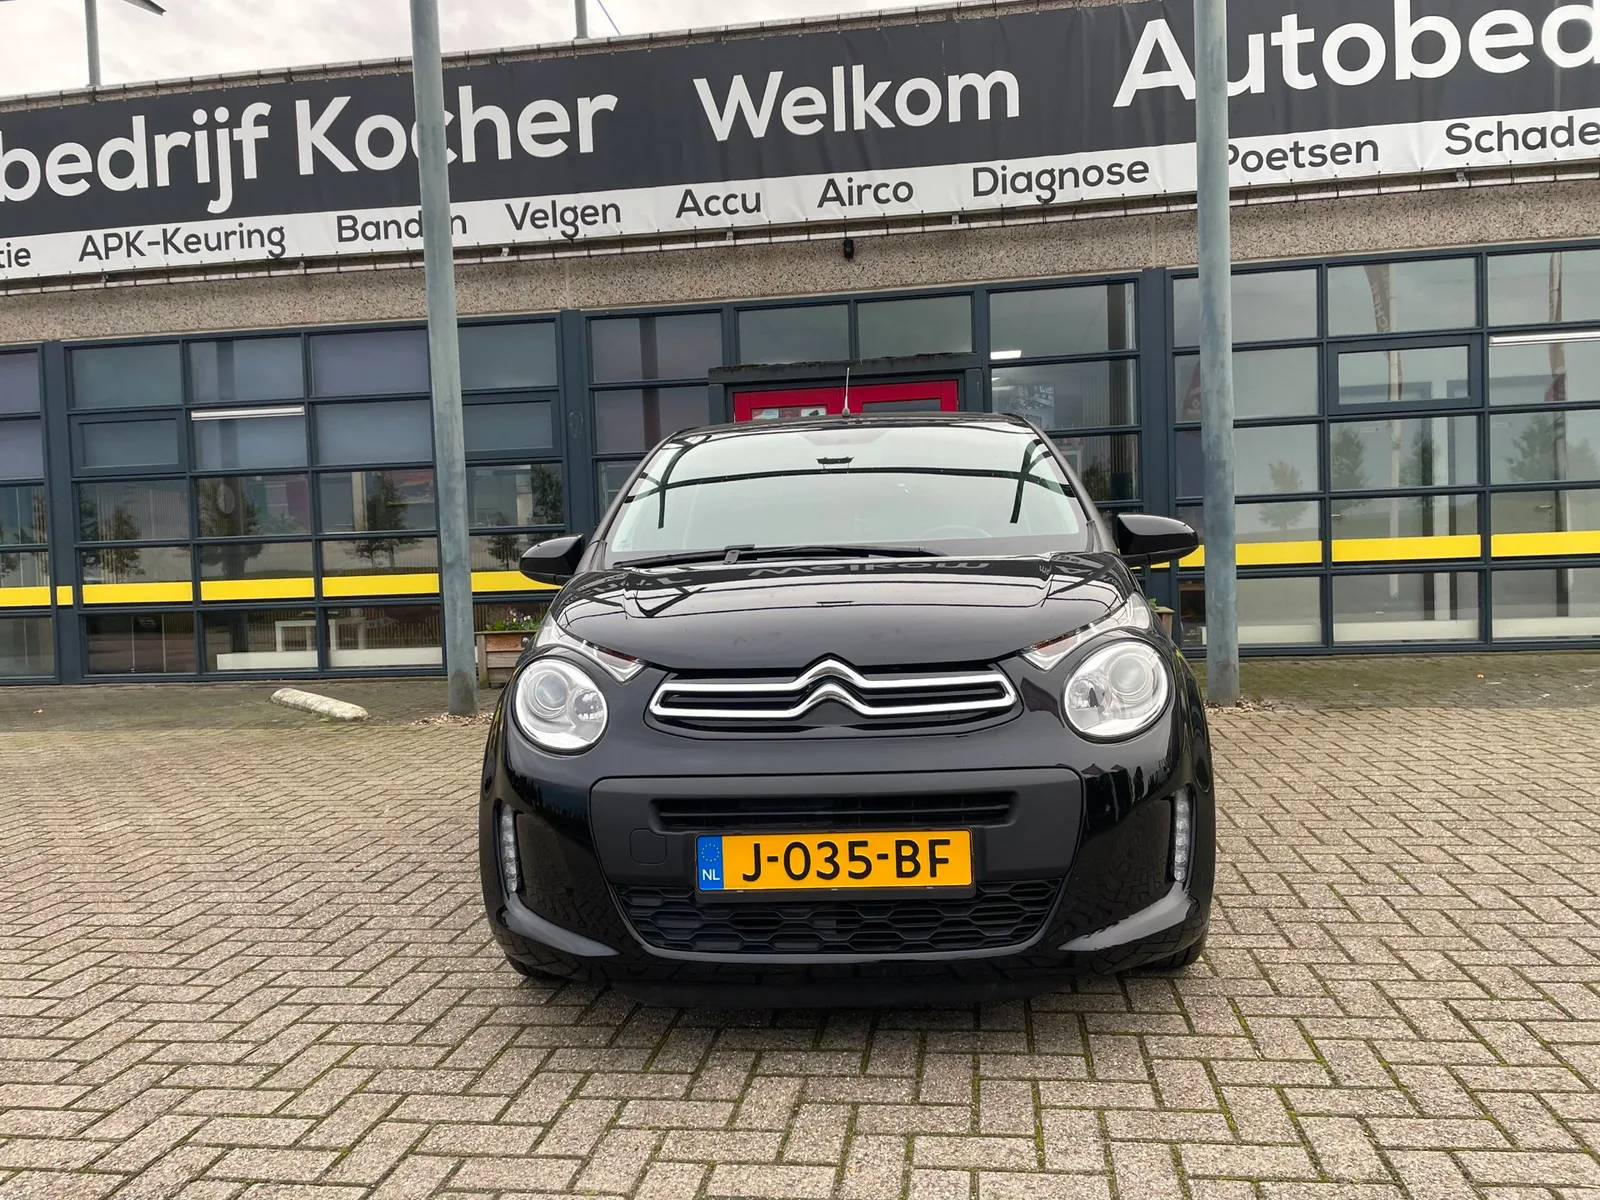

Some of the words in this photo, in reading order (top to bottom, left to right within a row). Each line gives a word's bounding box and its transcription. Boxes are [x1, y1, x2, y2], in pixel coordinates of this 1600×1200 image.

[0, 102, 270, 214] bedrijf
[693, 64, 1020, 141] Welkom
[79, 223, 286, 261] APK-Keuring
[337, 210, 467, 242] Bandn
[505, 201, 621, 239] Velgen
[676, 189, 762, 218] Accu
[817, 177, 914, 208] Airco
[973, 161, 1150, 203] Diagnose
[1445, 116, 1600, 155] Schade
[702, 868, 721, 881] NL
[742, 839, 951, 882] J-035-BF
